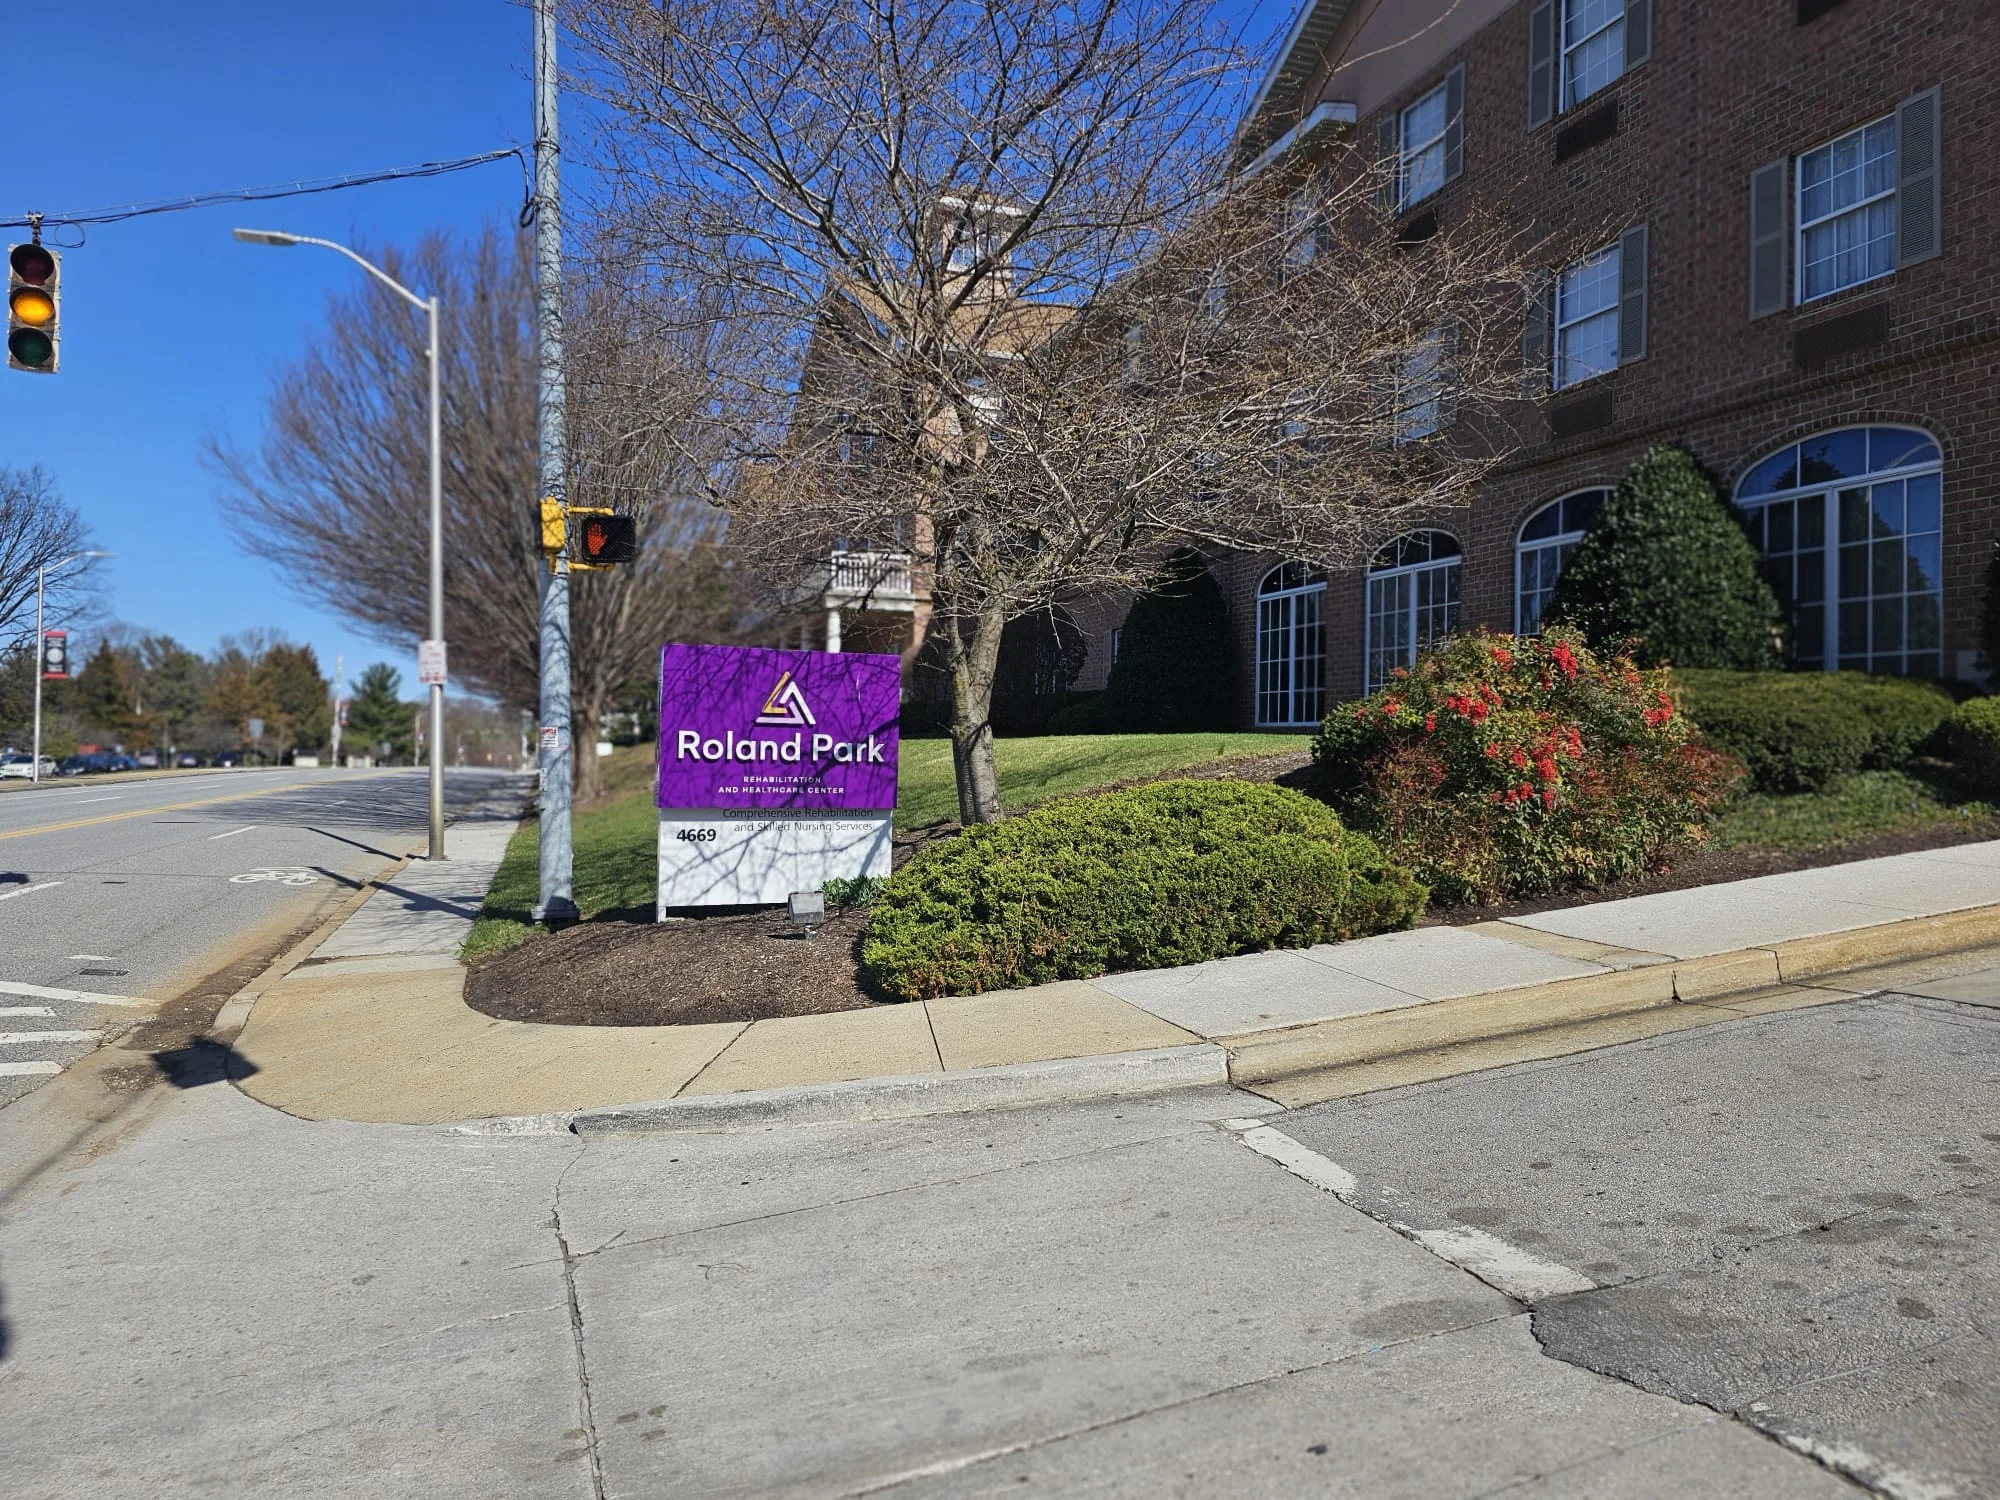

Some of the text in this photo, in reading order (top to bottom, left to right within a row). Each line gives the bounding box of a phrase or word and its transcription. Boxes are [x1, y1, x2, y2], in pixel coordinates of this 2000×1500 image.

[677, 730, 885, 763] Roland Park
[743, 776, 821, 784] REHABILITATION
[718, 786, 739, 794] AND
[742, 786, 804, 794] HEALTHCARE
[722, 808, 874, 820] Comprehensive Rehabilitation
[734, 821, 873, 833] and Skilled Nursing Services
[676, 828, 717, 842] 4669
